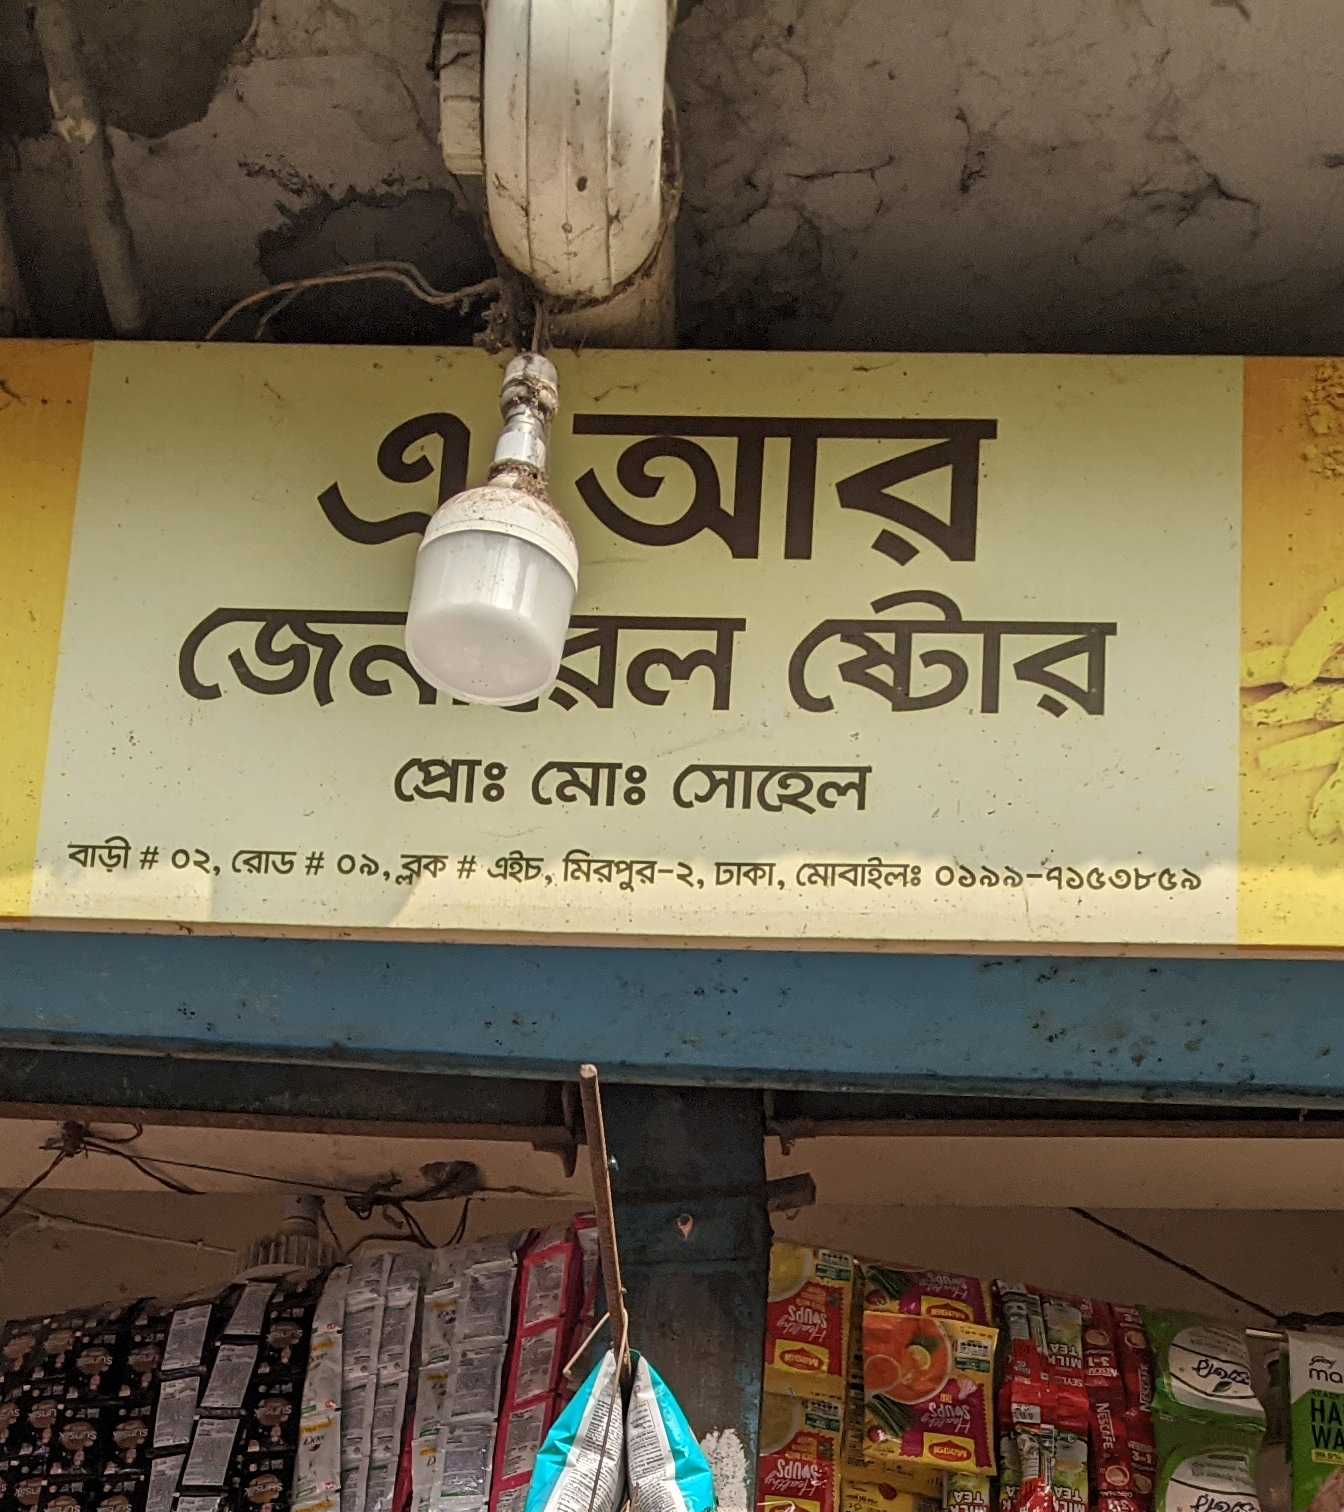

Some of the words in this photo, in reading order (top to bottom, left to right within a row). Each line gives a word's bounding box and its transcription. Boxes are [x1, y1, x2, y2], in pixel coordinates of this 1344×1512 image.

[317, 412, 470, 545] এ
[573, 414, 998, 567] আর
[788, 590, 1117, 718] ষ্টোর
[394, 757, 508, 803] প্রোঃ
[532, 761, 647, 806] মোঃ
[673, 764, 872, 815] সোহেল
[67, 836, 132, 872] বাড়ী
[139, 846, 159, 870] #
[172, 849, 220, 876] ০২,
[232, 850, 297, 874] রোড
[305, 851, 324, 875] #
[337, 854, 390, 878] ০৯,
[395, 853, 448, 886] ব্লক
[457, 855, 476, 879] #
[487, 854, 553, 886] এইচ,
[562, 849, 704, 892] মিরপুর-২,
[715, 860, 785, 890] ঢাকা,
[796, 857, 921, 889] মোবাইলঃ
[952, 1490, 984, 1506] TEA
[1054, 1486, 1081, 1501] TEA
